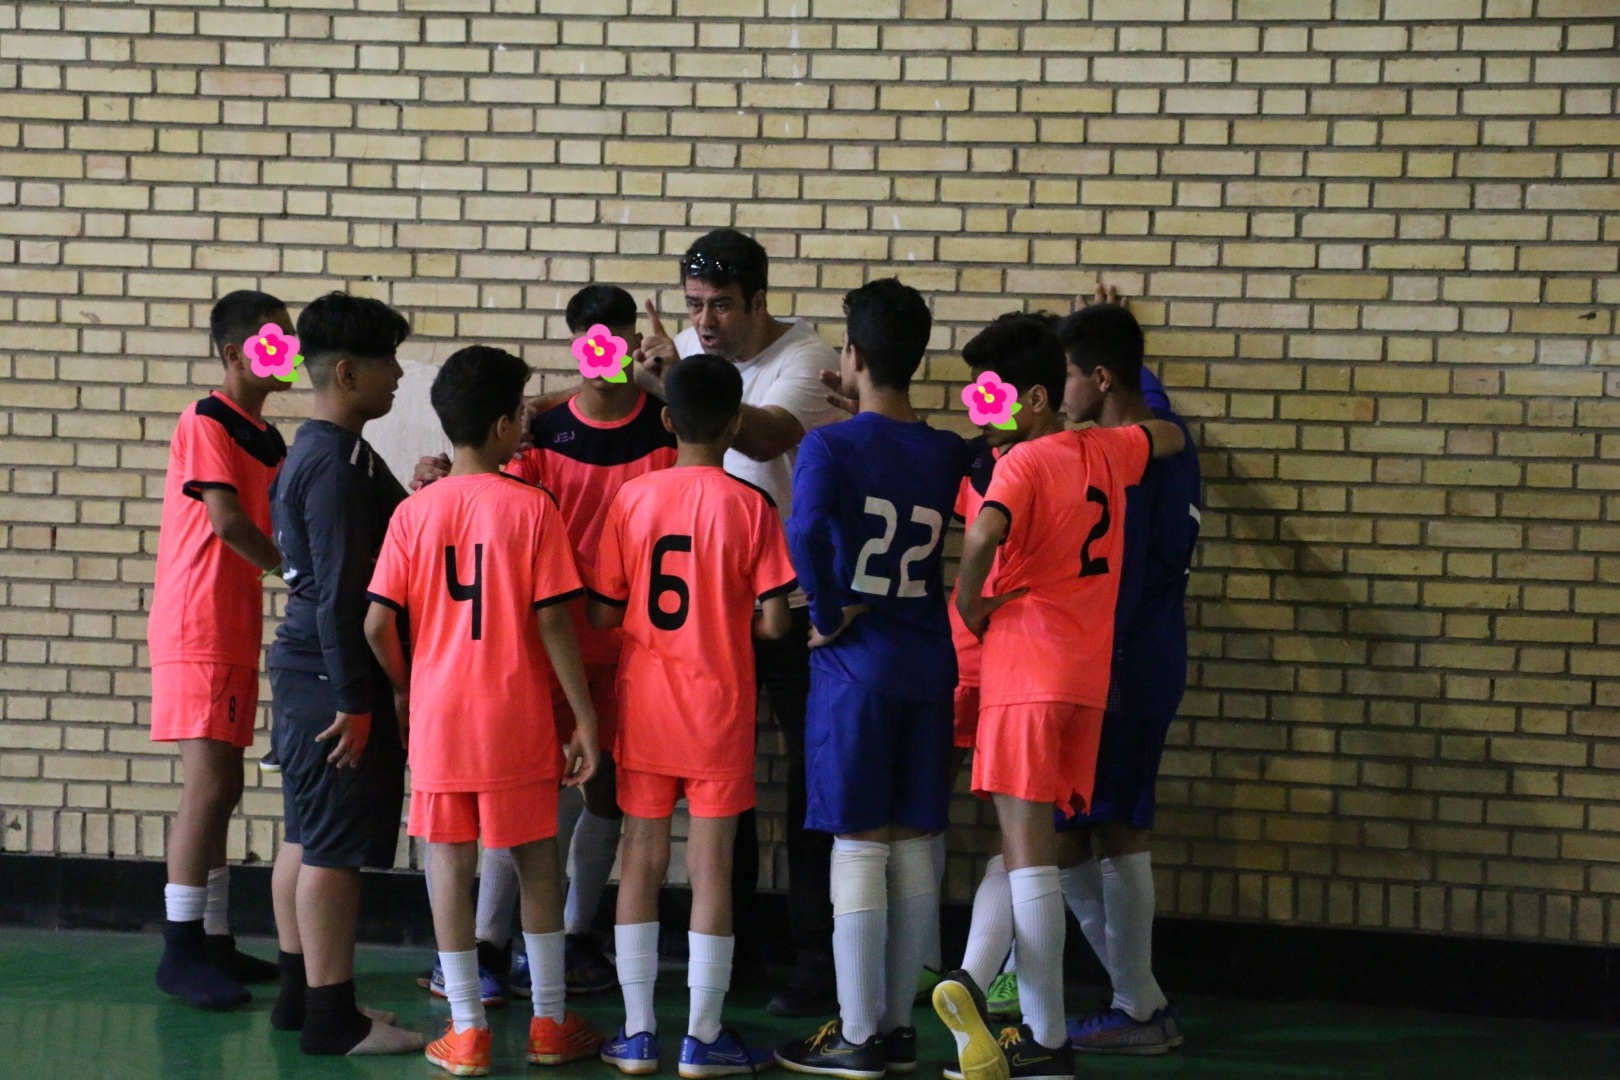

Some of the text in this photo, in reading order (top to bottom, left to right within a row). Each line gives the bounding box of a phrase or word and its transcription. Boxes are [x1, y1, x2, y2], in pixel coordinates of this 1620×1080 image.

[554, 431, 575, 443] JEJ
[851, 496, 943, 598] 22
[1078, 486, 1111, 578] 2
[445, 543, 483, 641] 4
[648, 534, 692, 631] 6
